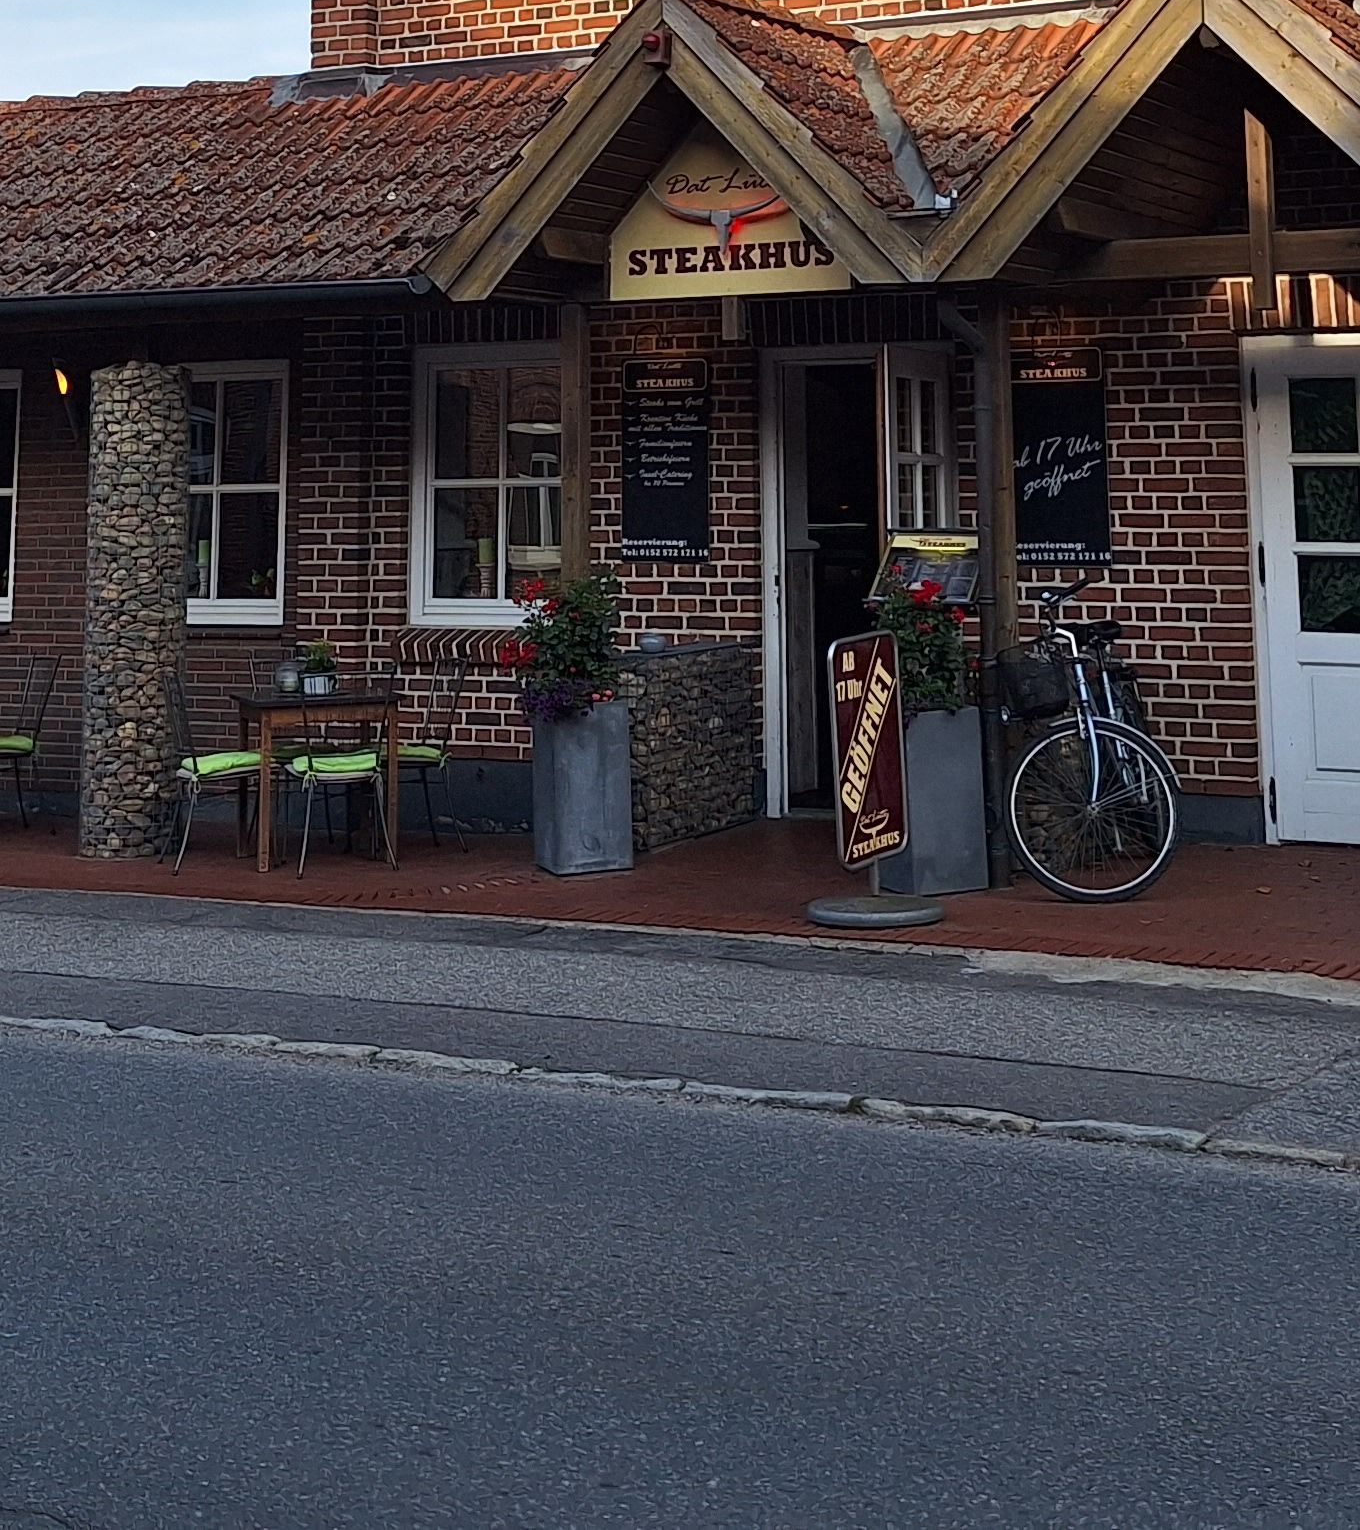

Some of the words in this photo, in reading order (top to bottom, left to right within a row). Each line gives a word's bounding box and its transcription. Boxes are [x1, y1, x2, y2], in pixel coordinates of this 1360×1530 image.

[665, 173, 724, 195] Dat
[719, 167, 772, 193] Lüt
[628, 240, 834, 276] STEAKHUS
[1036, 436, 1062, 465] 17
[1065, 434, 1103, 458] Uhr
[1023, 459, 1102, 502] geöffnet
[1016, 541, 1086, 551] eservierung:
[1016, 552, 1030, 561] el:
[842, 651, 855, 673] AB
[835, 681, 846, 703] 17
[847, 678, 863, 700] Uhr
[841, 656, 893, 814] GEÖFFNET
